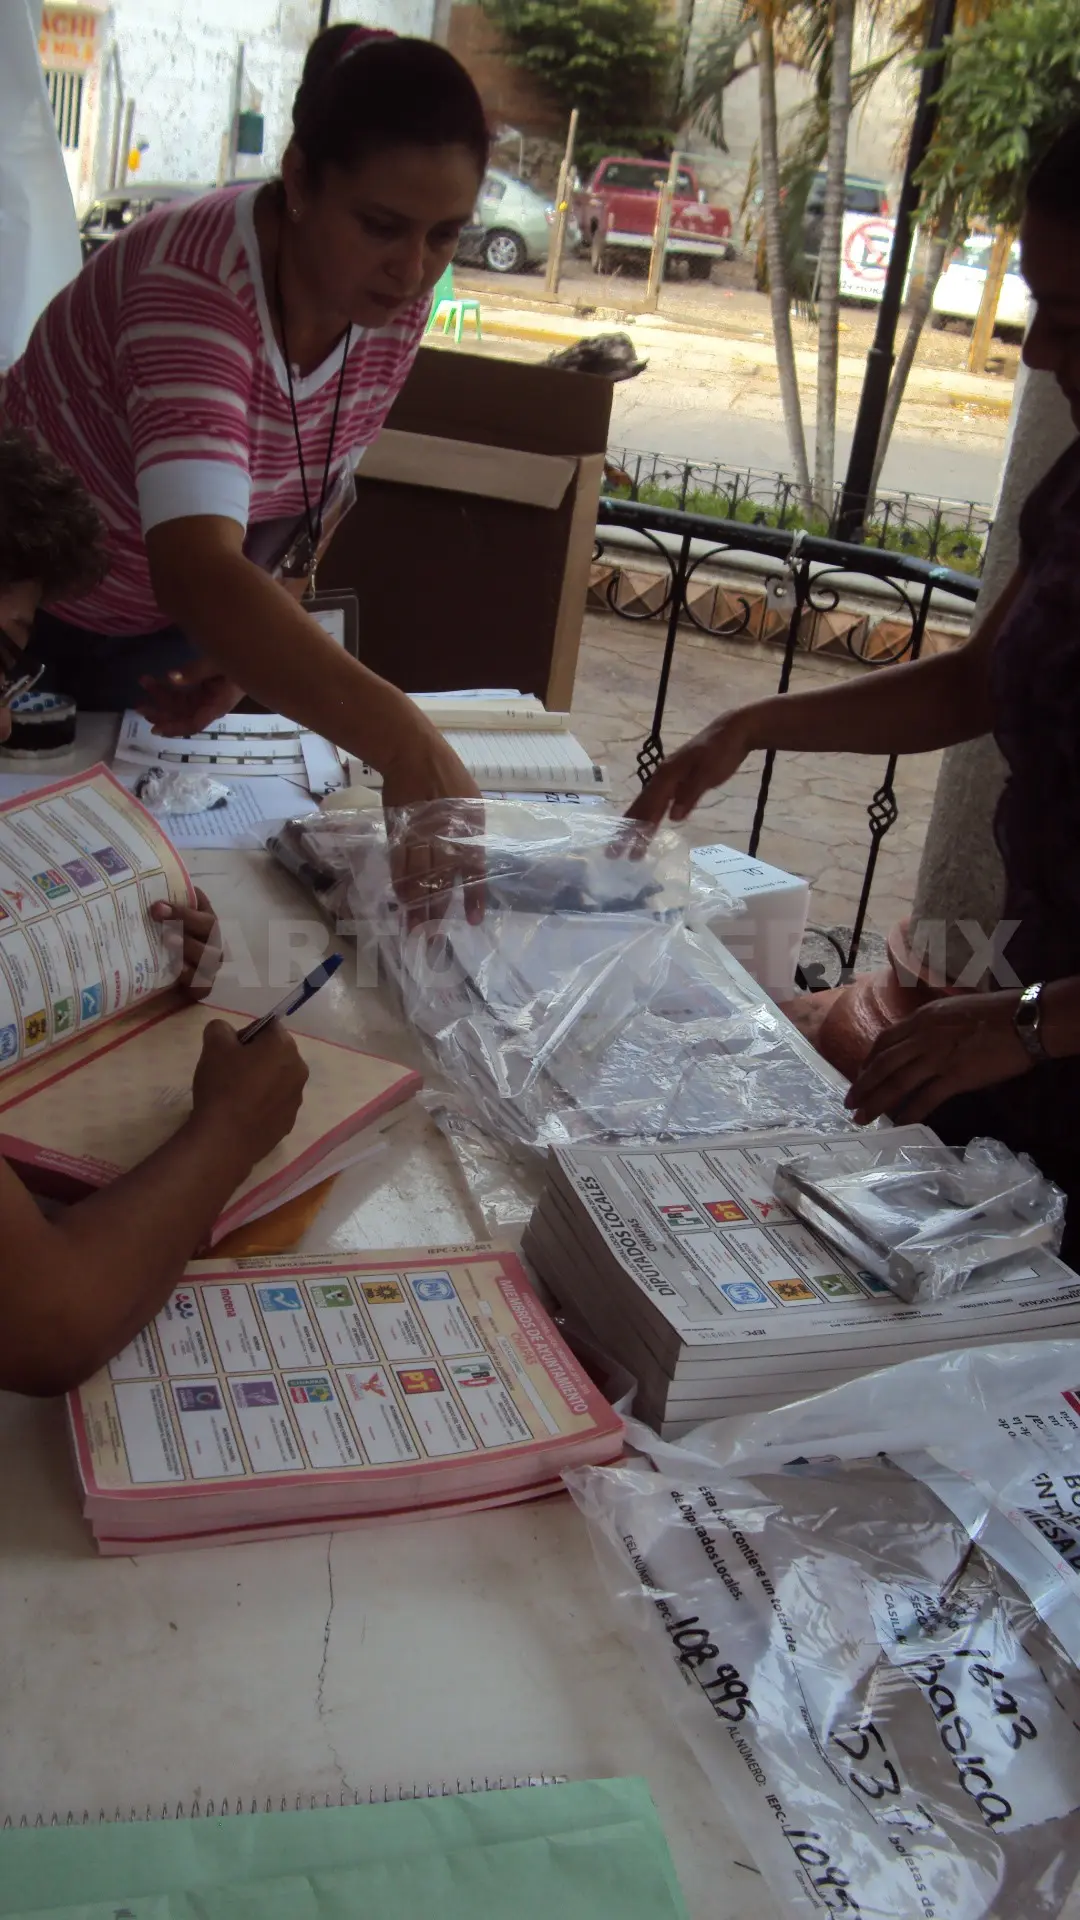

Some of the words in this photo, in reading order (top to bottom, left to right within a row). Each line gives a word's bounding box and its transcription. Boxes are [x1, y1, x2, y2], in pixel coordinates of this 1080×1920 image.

[580, 1175, 626, 1228] LOCALES
[626, 1218, 658, 1253] CHIAPAS
[614, 1231, 677, 1296] DIPUTADOS
[220, 1288, 236, 1318] morena
[499, 1279, 536, 1331] MIEMBROS
[510, 1332, 538, 1366] CHIAPAS
[527, 1327, 545, 1341] DE
[402, 1370, 430, 1391] PT
[535, 1340, 589, 1413] AYUNTAMIENTO
[670, 1490, 685, 1505] de
[712, 1558, 744, 1602] Locales.
[731, 1530, 767, 1579] contiene
[760, 1577, 777, 1597] un
[770, 1598, 795, 1633] total
[784, 1634, 799, 1653] de
[726, 1726, 738, 1740] AL
[765, 1794, 788, 1824] IEPC-
[887, 1836, 928, 1893] boletas
[920, 1898, 936, 1919] de
